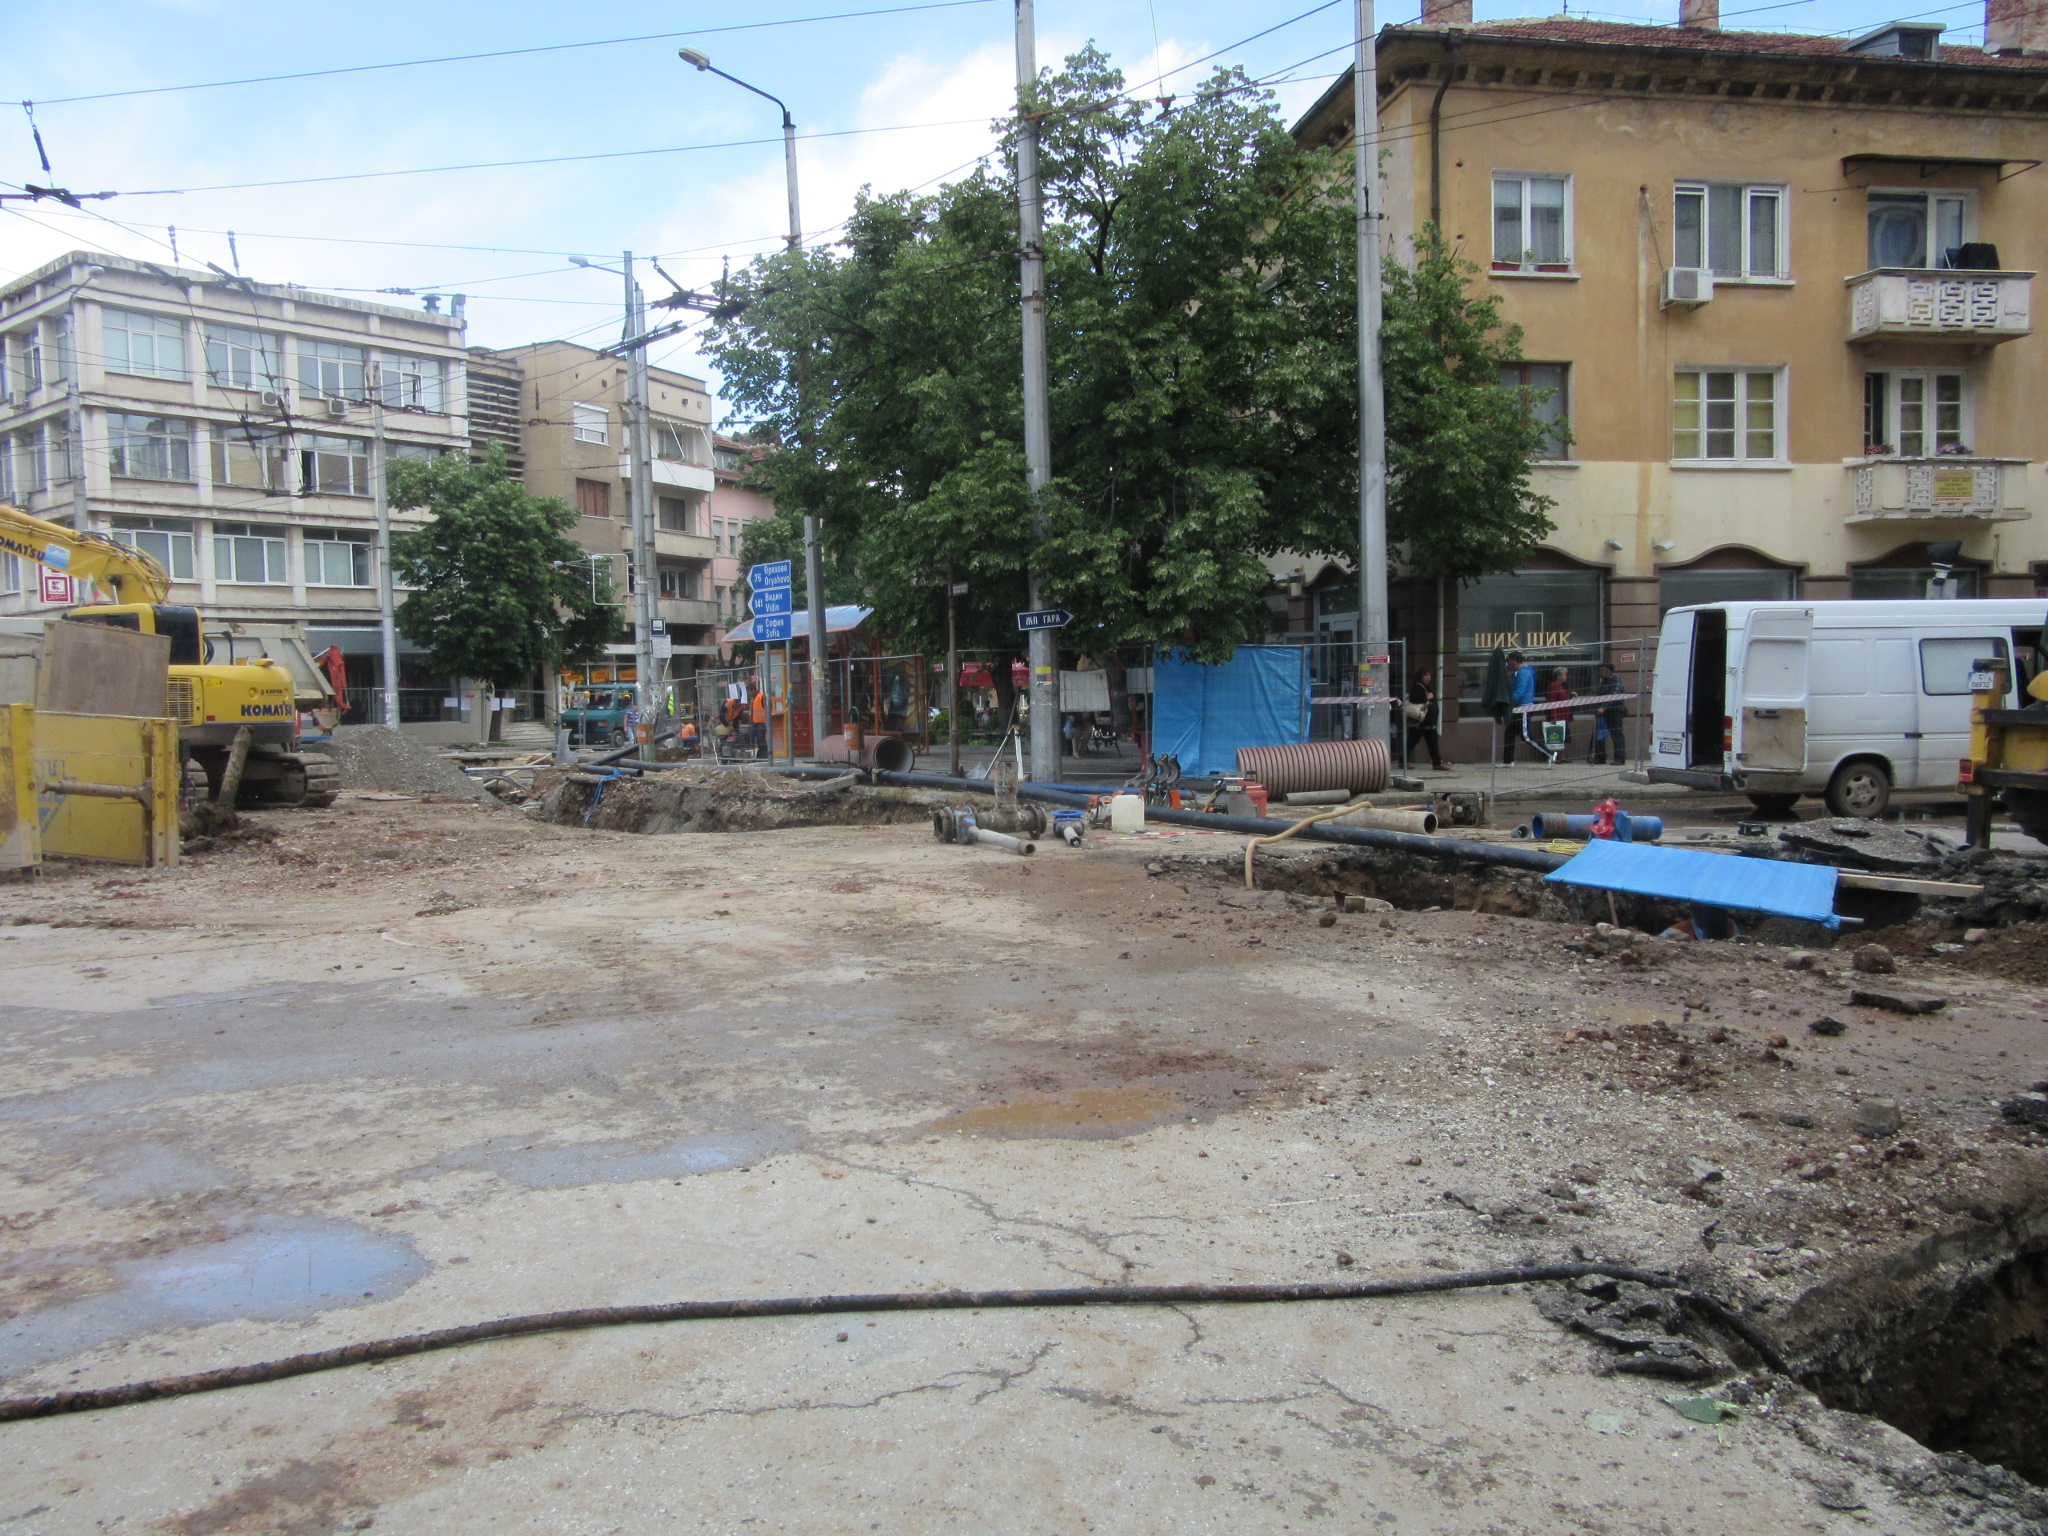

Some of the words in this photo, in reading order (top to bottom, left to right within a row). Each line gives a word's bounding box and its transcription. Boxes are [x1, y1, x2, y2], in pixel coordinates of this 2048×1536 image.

[0, 535, 45, 561] OMATSU
[763, 565, 788, 576] Оряхово
[754, 573, 762, 583] 76
[764, 575, 790, 587] Oryahovo
[764, 592, 783, 602] Видин
[754, 599, 763, 609] 141
[765, 603, 780, 613] Vidin
[765, 618, 785, 628] София
[1025, 616, 1038, 626] ЖП
[1042, 613, 1061, 624] ГАРА
[765, 629, 780, 638] Sofia
[1474, 632, 1522, 649] ШИК
[1526, 631, 1581, 649] ШИК
[240, 701, 293, 717] KOMATSU
